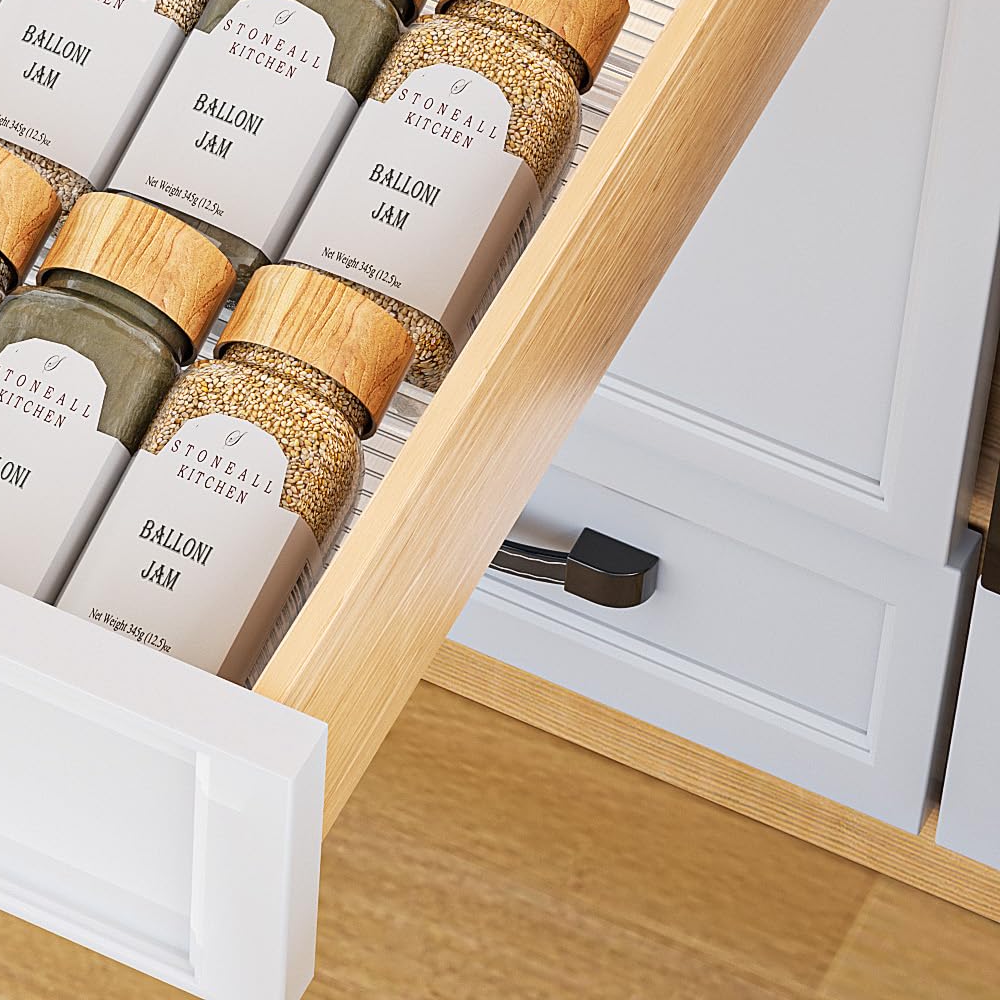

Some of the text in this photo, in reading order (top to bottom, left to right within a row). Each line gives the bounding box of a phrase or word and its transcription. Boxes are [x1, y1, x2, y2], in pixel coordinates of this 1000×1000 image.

[21, 24, 91, 66] BALLONI
[222, 18, 320, 69] STONEALL
[228, 41, 297, 78] KITCHEN
[22, 61, 61, 90] JAM
[8, 119, 26, 136] 345g
[192, 93, 264, 136] BALLONI
[398, 88, 497, 139] STONEALL
[404, 111, 473, 148] KITCHEN
[194, 130, 233, 159] JAM
[144, 175, 158, 188] Net
[158, 179, 182, 197] Weight
[180, 189, 199, 206] 345g
[368, 163, 441, 207] BALLONI
[371, 201, 410, 230] JAM
[321, 246, 335, 259] Net
[335, 251, 359, 269] Weight
[357, 261, 376, 278] 345g
[170, 439, 272, 494] STONEALL
[176, 463, 248, 504] KITCHEN
[138, 519, 213, 566] BALLONI
[140, 559, 181, 591] JAM
[88, 607, 103, 621] Net
[102, 612, 128, 631] Weight
[125, 623, 145, 642] 345g
